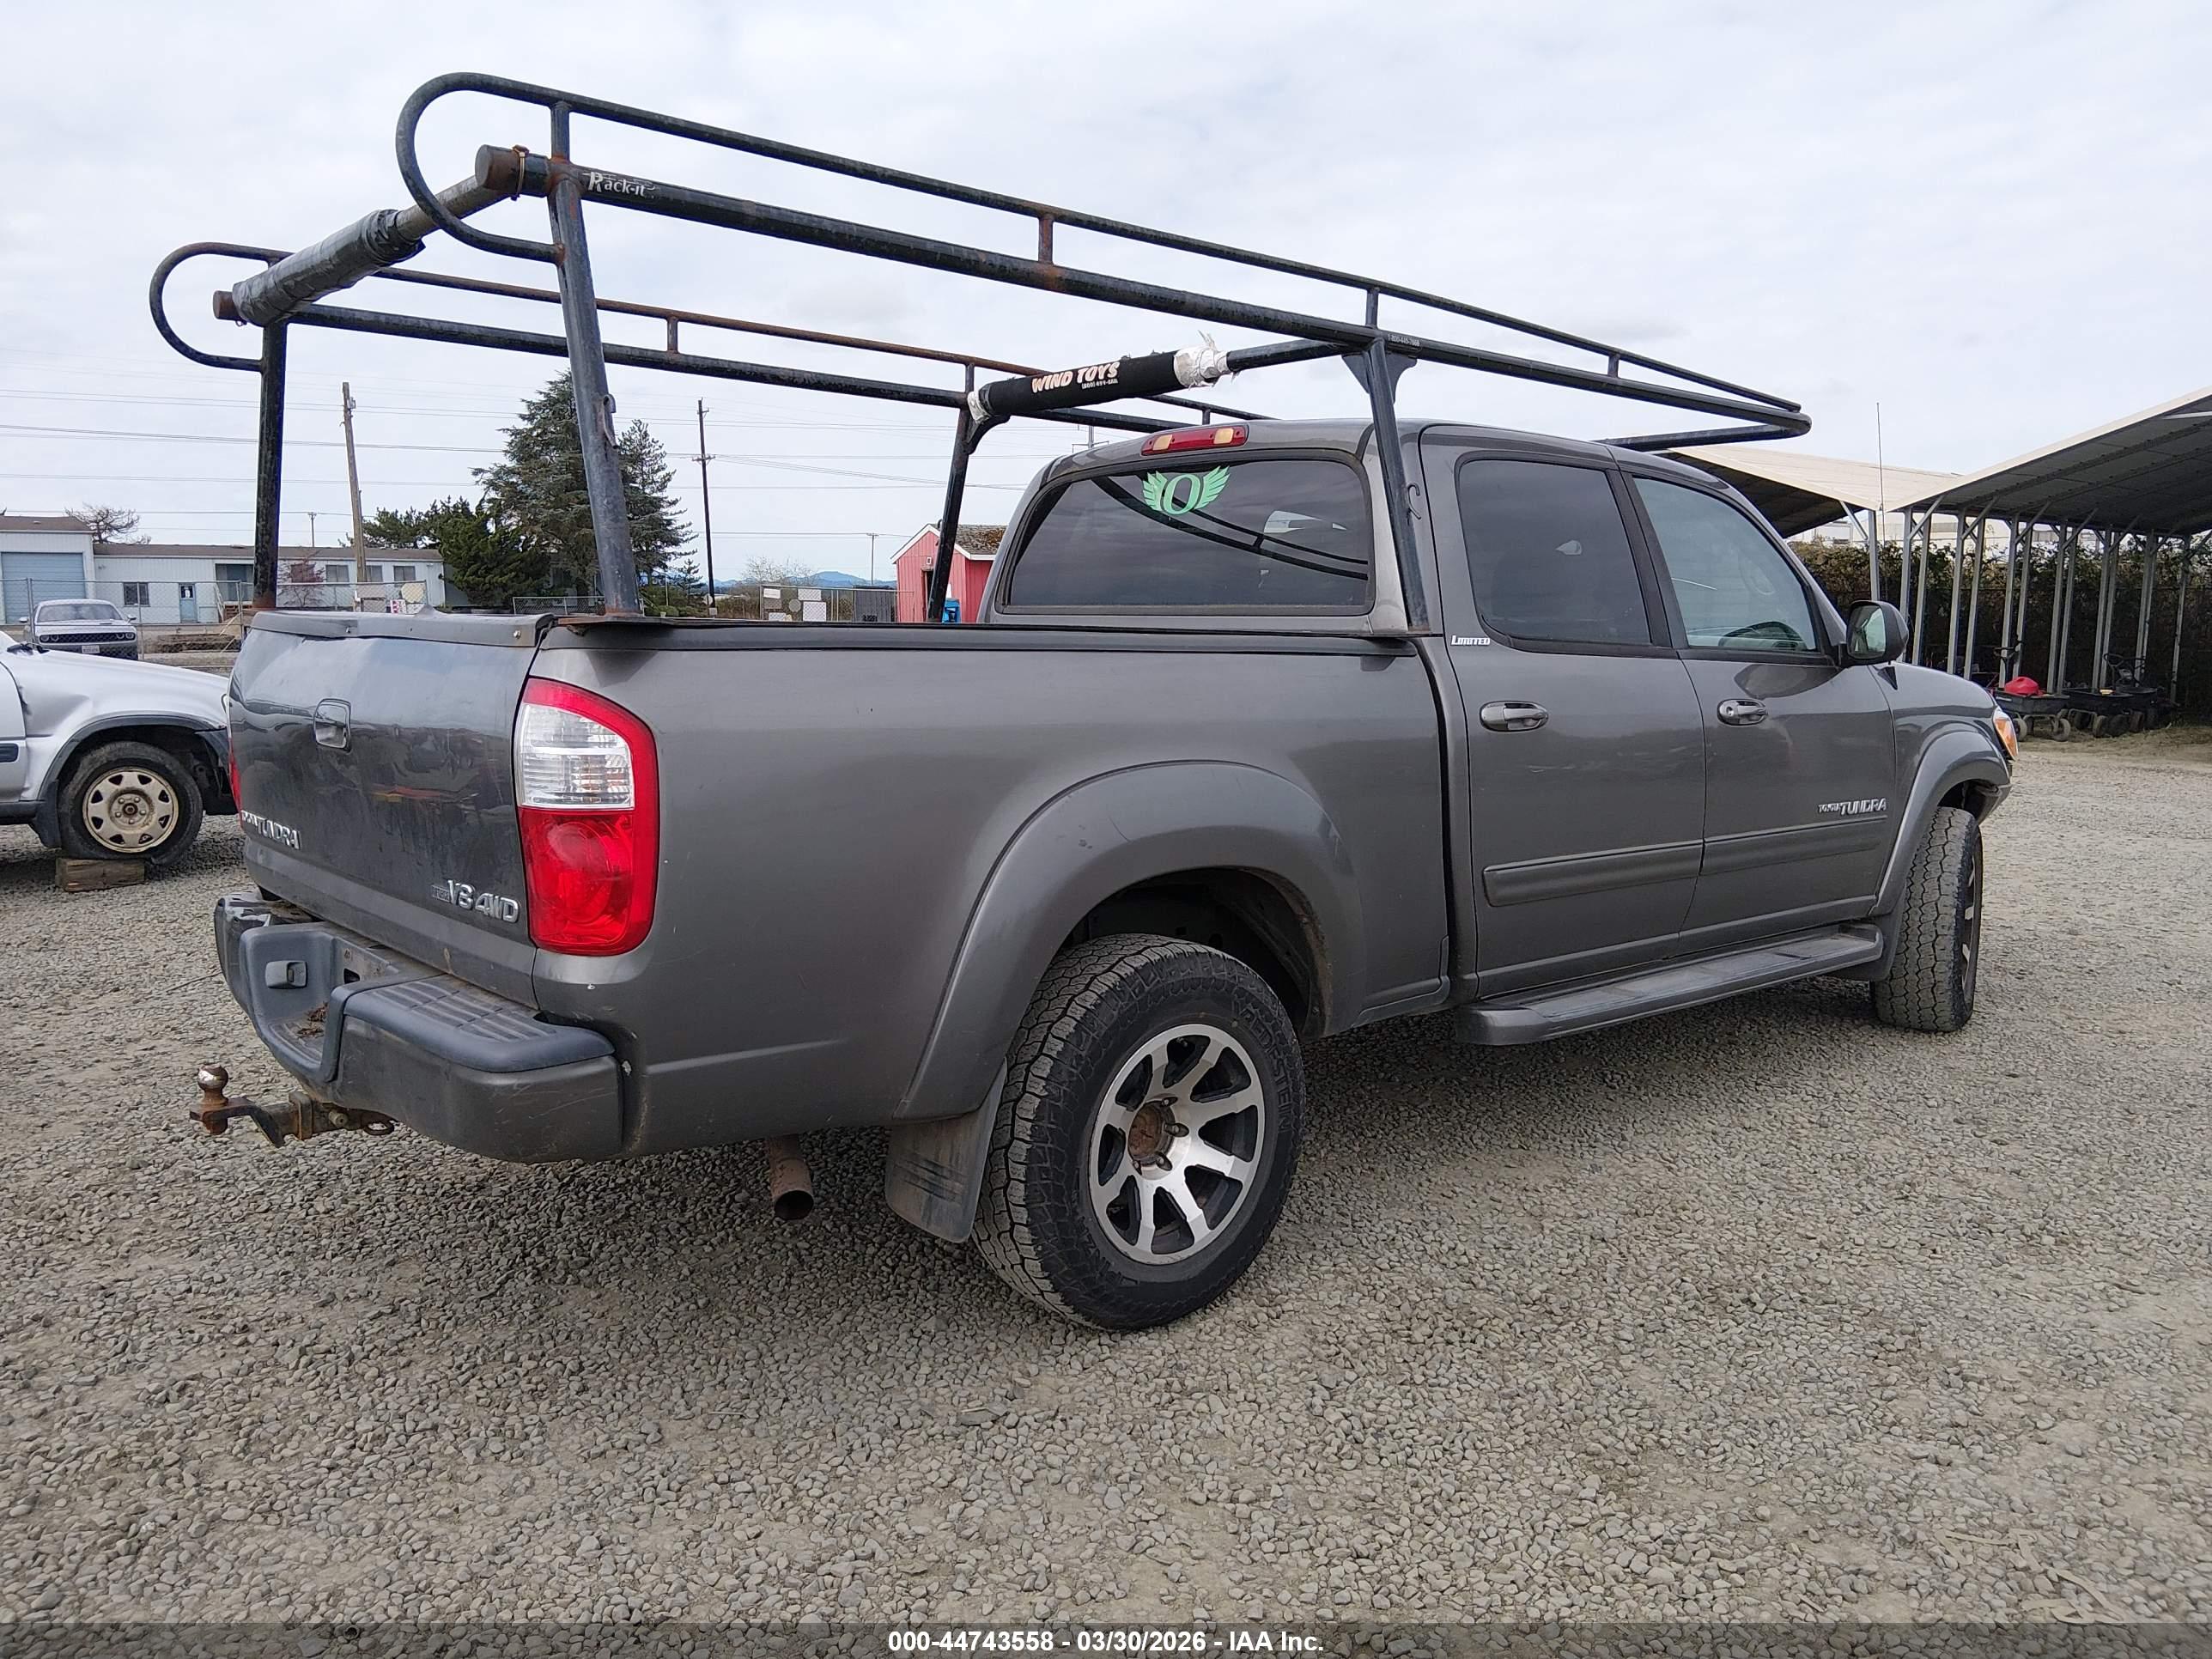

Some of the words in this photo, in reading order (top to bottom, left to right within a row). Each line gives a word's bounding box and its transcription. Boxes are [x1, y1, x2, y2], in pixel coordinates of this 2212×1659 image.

[1031, 371, 1073, 393] WIND
[1077, 362, 1120, 383] TOYS
[1840, 798, 1887, 816] TUNDRA
[447, 879, 476, 911] V8
[475, 892, 520, 923] 4WD
[1231, 998, 1291, 1133] VREDESTEIN
